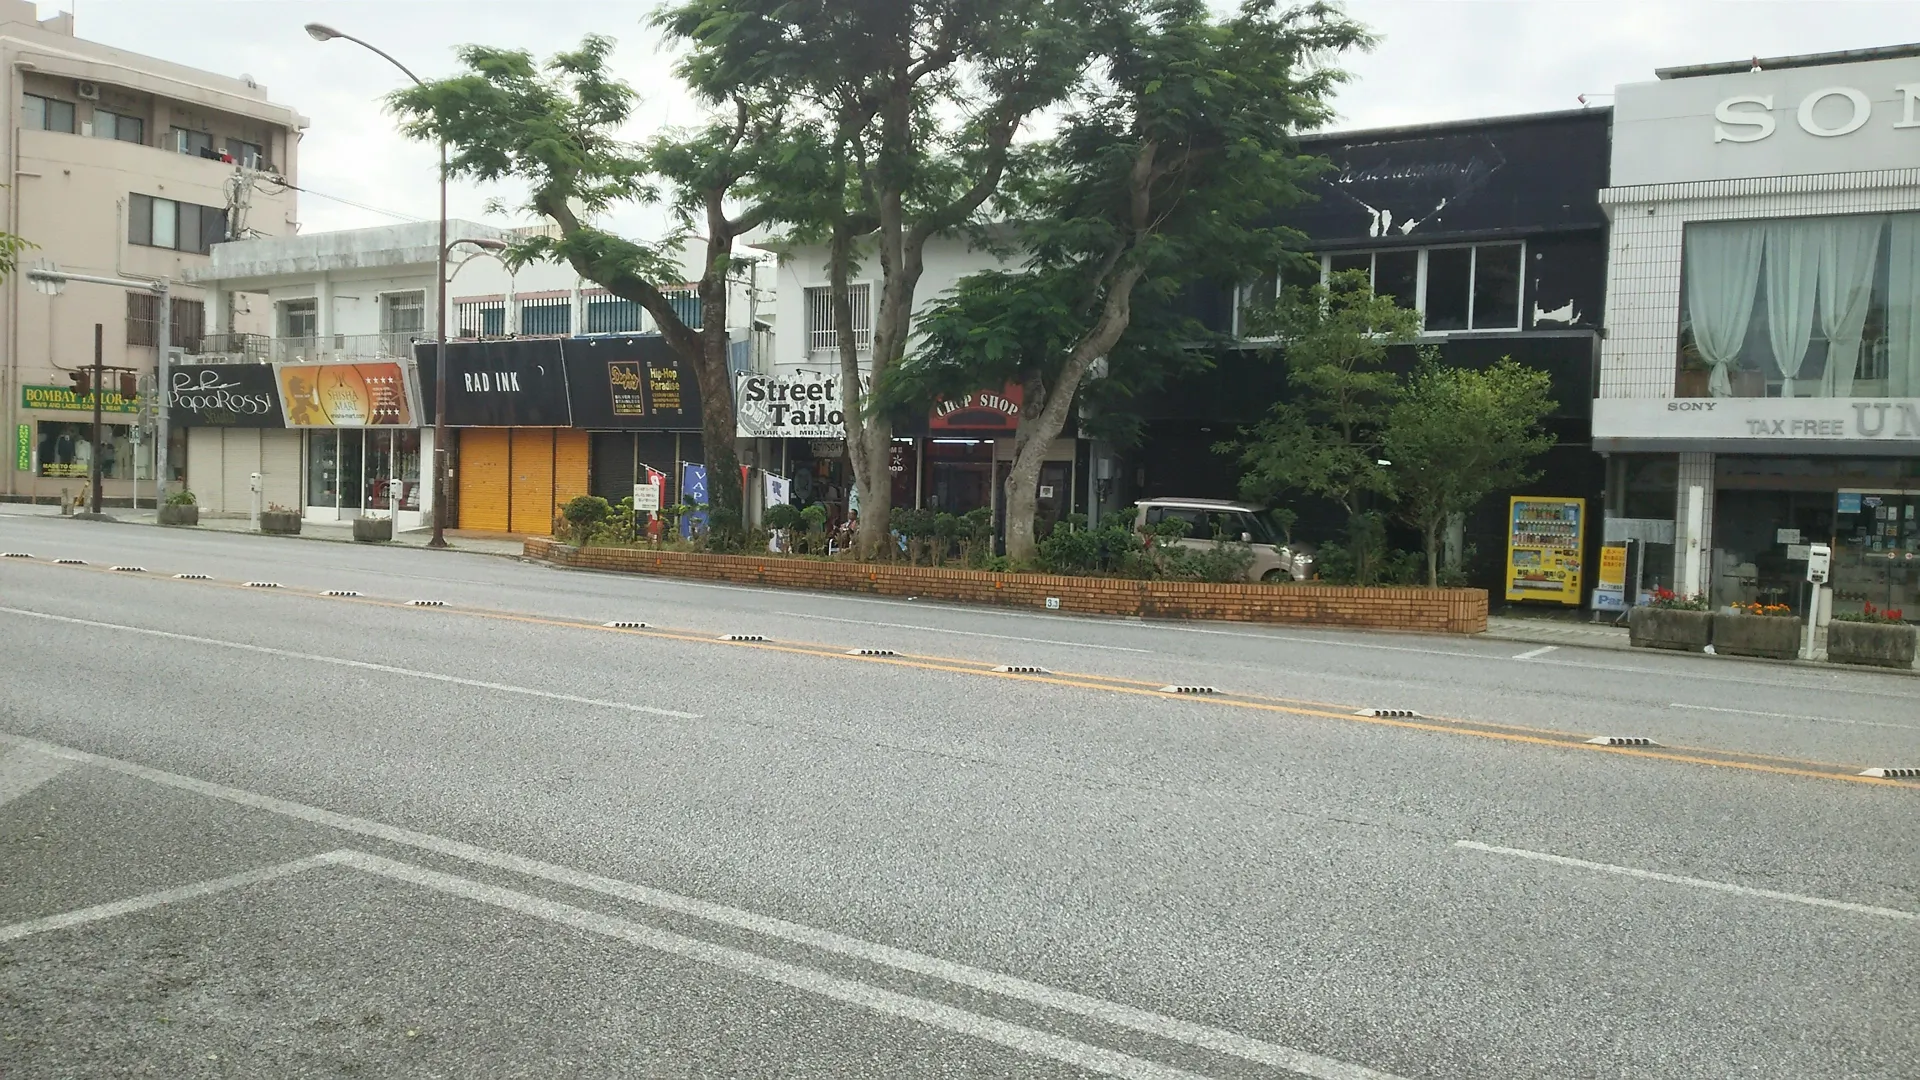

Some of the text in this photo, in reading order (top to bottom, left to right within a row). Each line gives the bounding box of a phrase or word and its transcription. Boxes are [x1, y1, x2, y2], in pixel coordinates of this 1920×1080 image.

[650, 368, 677, 380] Hip-Hop
[464, 372, 520, 392] RAD INK
[651, 380, 680, 391] Paradise
[26, 389, 77, 403] BOMBAY
[328, 390, 359, 401] SHISHA
[746, 378, 834, 401] Street
[168, 390, 271, 414] PapaRossi
[335, 401, 358, 411] MART
[980, 395, 1019, 416] SHOP
[1667, 402, 1717, 411] SONY
[1746, 419, 1785, 435] TAX
[1791, 419, 1844, 435] FREE
